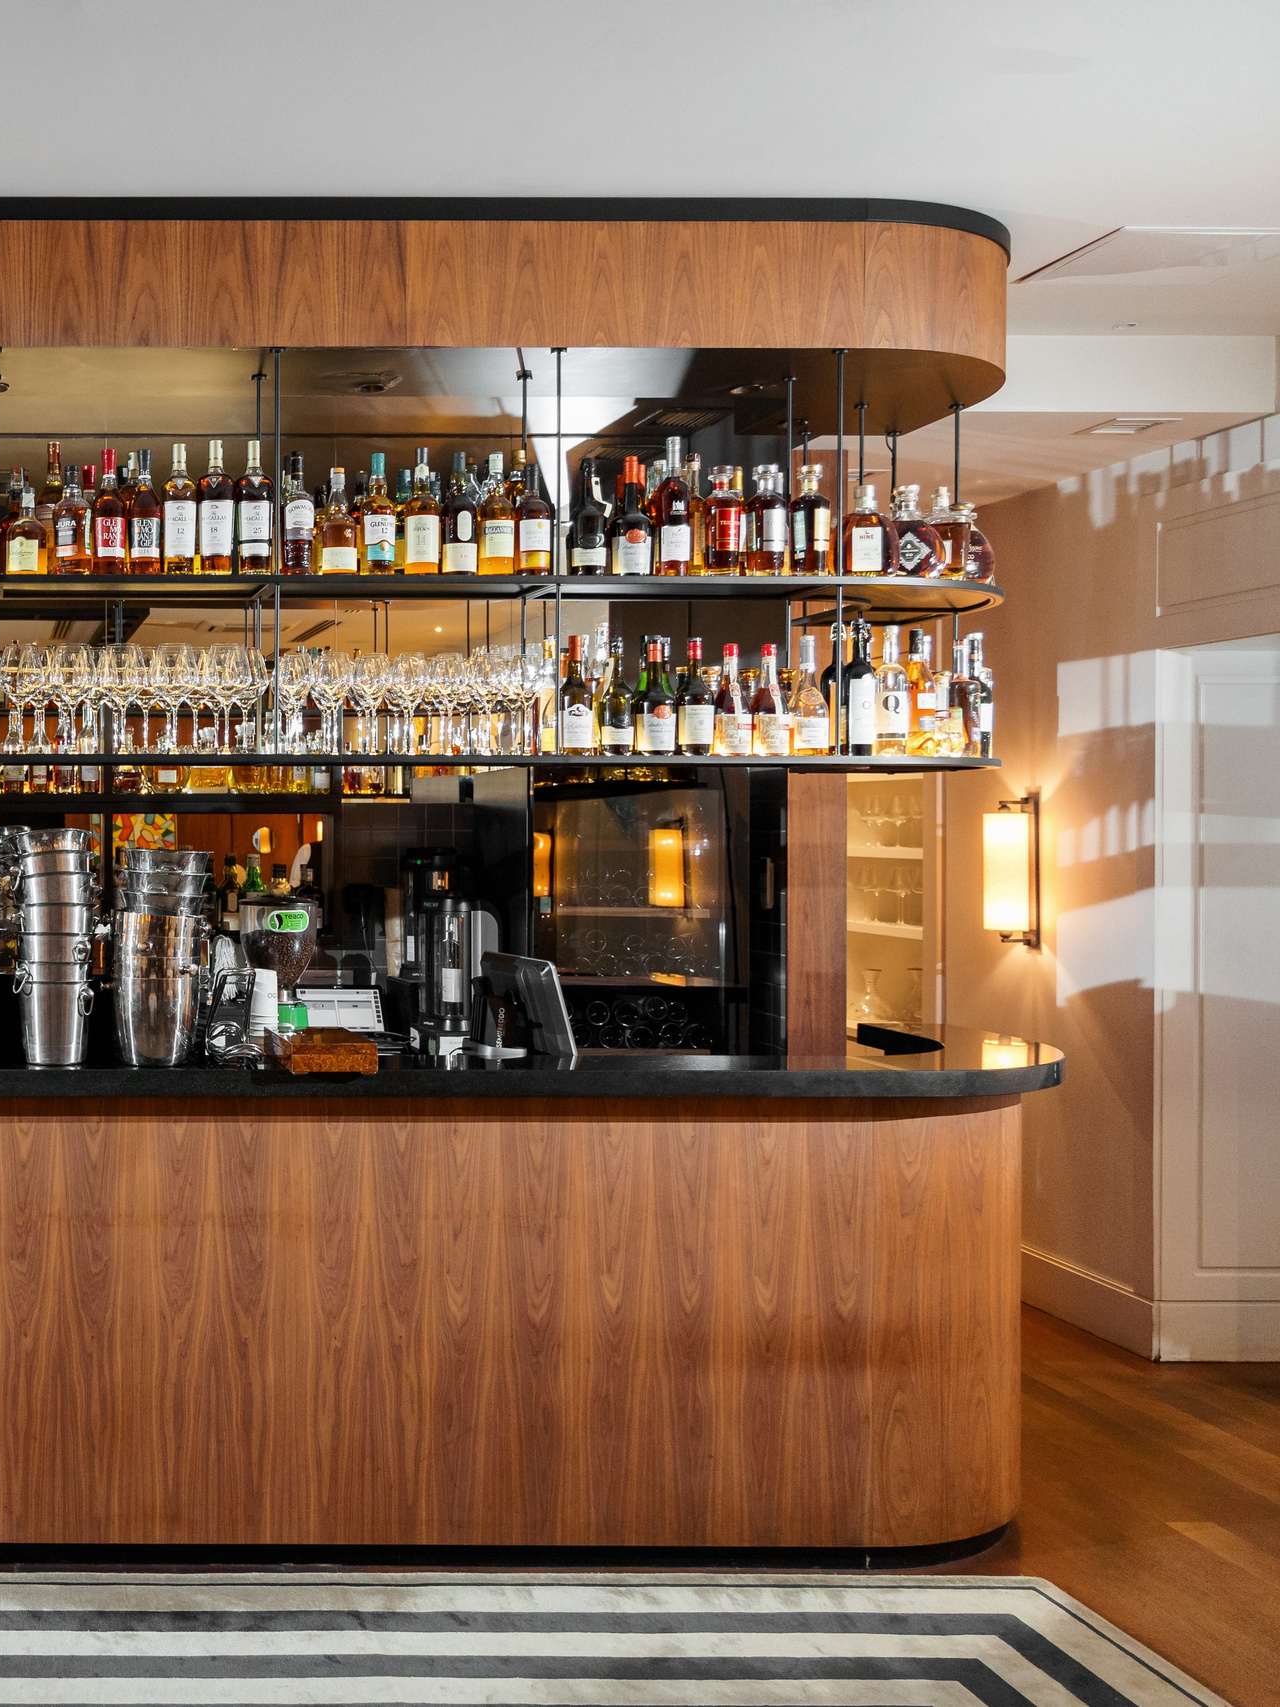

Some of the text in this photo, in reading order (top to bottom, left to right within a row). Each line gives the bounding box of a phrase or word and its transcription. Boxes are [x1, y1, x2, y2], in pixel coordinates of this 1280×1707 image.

[55, 520, 77, 528] JURA
[417, 535, 426, 545] 14
[882, 695, 900, 714] Q
